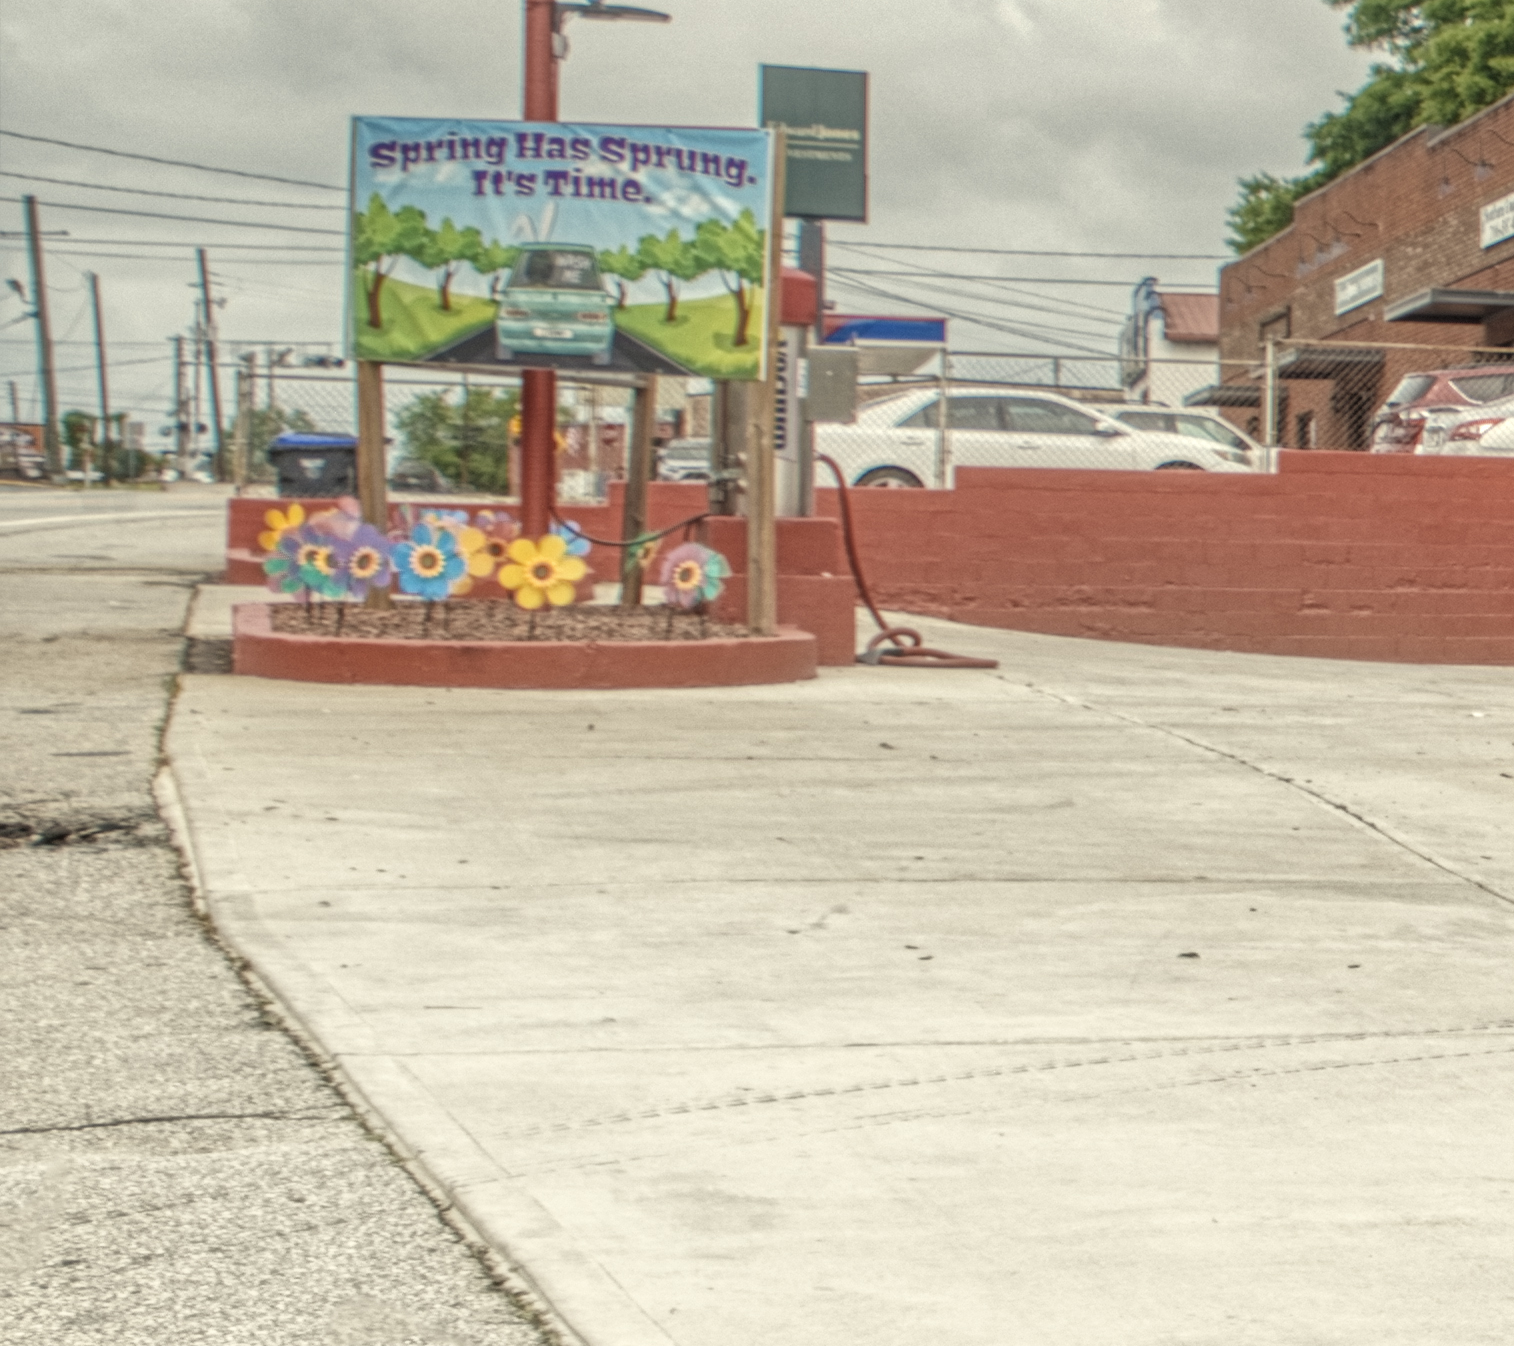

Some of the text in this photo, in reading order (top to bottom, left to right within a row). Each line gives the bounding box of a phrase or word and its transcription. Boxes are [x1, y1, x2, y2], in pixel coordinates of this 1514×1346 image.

[369, 130, 758, 189] Spring Has Sprung.
[471, 167, 654, 204] It's Time.
